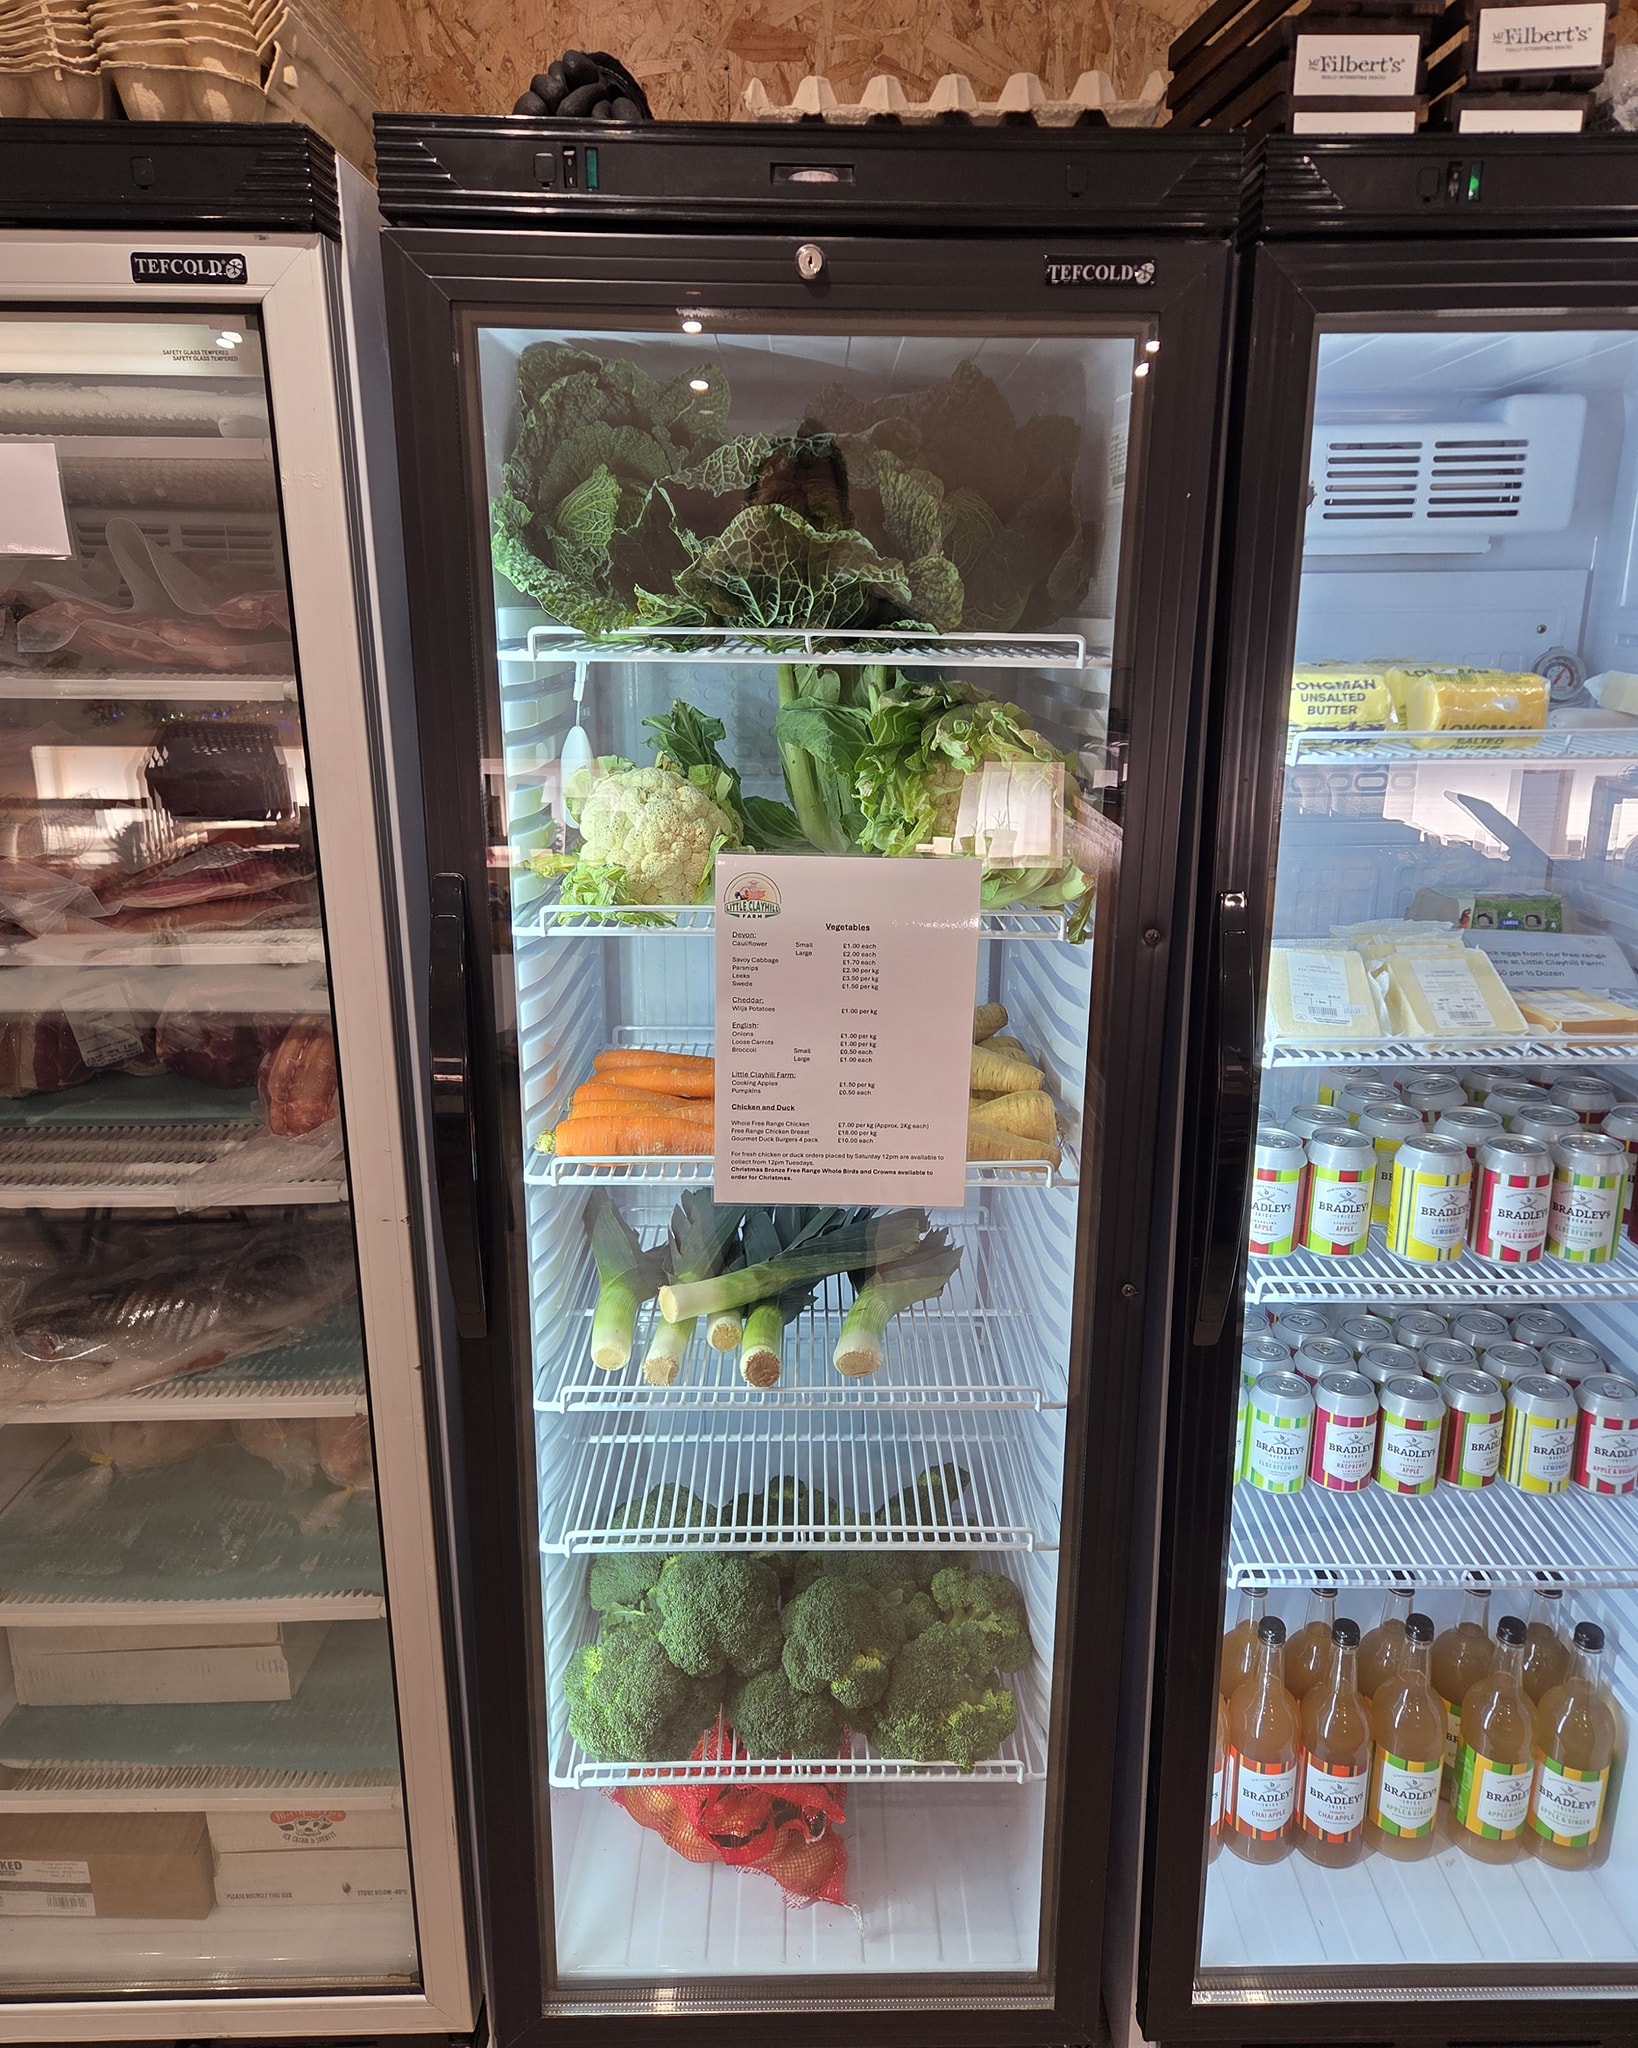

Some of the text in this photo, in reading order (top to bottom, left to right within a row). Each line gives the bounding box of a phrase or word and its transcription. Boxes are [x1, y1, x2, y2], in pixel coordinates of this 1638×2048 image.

[1505, 25, 1588, 45] Filbert's
[1320, 55, 1402, 72] Filbert's
[135, 259, 222, 274] TEFCOLD
[1049, 265, 1133, 280] TEFCOLD
[1300, 693, 1365, 703] UNSALTED
[1308, 705, 1357, 715] BUTTER
[726, 901, 779, 912] LITTLE CLAYHILL
[825, 923, 870, 932] Vegetables
[1545, 959, 1579, 967] Clayhill
[732, 1022, 759, 1030] English:
[750, 1071, 776, 1080] Clayhill
[1254, 1224, 1273, 1232] APPLE
[1496, 1230, 1517, 1239] APPLE
[1401, 1466, 1420, 1475] APPLE
[1251, 1809, 1286, 1818] CHAI APPLE
[1386, 1803, 1407, 1816] APPLE
[1318, 1811, 1354, 1821] CHAI APPLE
